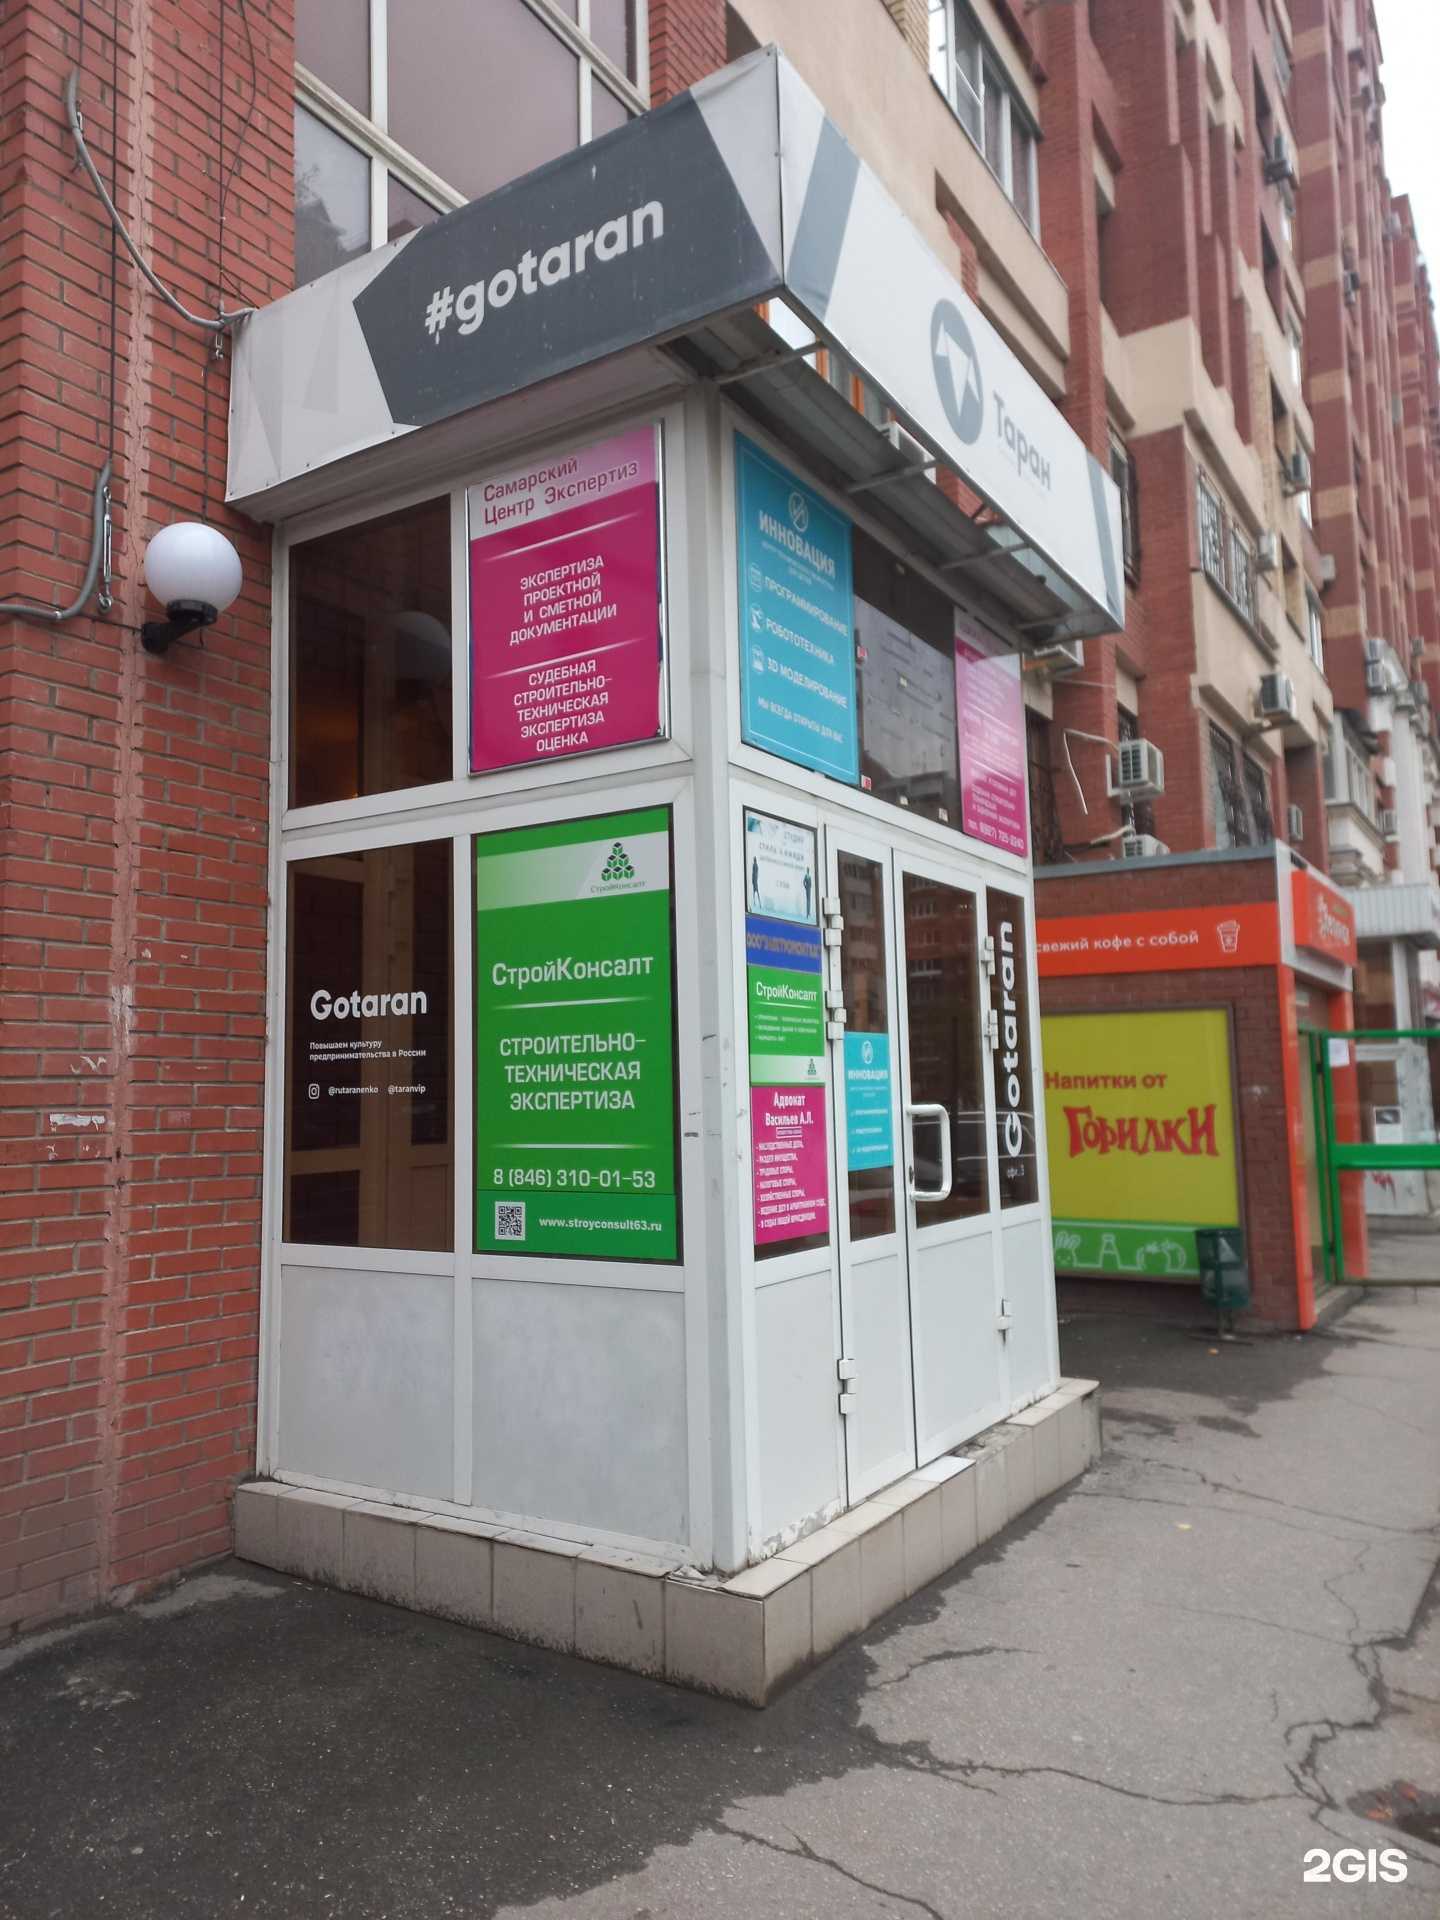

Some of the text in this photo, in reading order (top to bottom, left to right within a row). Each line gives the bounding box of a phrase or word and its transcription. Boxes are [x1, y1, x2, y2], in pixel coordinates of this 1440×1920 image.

[425, 200, 665, 336] #gotaran
[993, 389, 1051, 491] Таран
[484, 458, 578, 502] Самарский
[484, 462, 639, 525] Центр Экспертиз
[759, 510, 836, 579] ИННОВАЦИЯ
[520, 555, 604, 590] ЭКСПЕРТИЗА
[524, 573, 601, 606] ПРОЕКТНОЙ
[523, 590, 602, 624] И СМЕТНОЙ
[510, 603, 617, 646] ДОКУМЕНТАЦИИ
[528, 659, 596, 686] СУДЕБНАЯ
[513, 675, 613, 706] СТРОИТЕЛЬНО-
[517, 692, 609, 722] ТЕХНИЧЕСКАЯ
[520, 710, 605, 738] ЭКСПЕРТИЗА
[536, 731, 589, 751] ОЦЕНКА
[1094, 934, 1132, 951] кофе
[1136, 936, 1145, 947] с
[1150, 929, 1199, 946] собой
[492, 956, 654, 990] СтройКонсалт
[310, 989, 427, 1020] Gotaran
[309, 1040, 383, 1051] Повышаем культуру
[500, 1032, 646, 1056] СТРОИТЕЛЬНО-
[1000, 921, 1023, 1158] Gotaran
[309, 1051, 391, 1062] предпринимательства
[398, 1050, 427, 1058] России
[504, 1061, 641, 1083] ТЕХНИЧЕСКАЯ
[1044, 1071, 1167, 1090] Напитки от
[387, 1083, 427, 1096] @taranvip
[510, 1090, 636, 1111] ЭКСПЕРТИЗА
[773, 1091, 806, 1108] Адвокат
[493, 1168, 656, 1188] 8 (846) 310-01-53
[538, 1217, 662, 1232] www.stroyconsult63.ru
